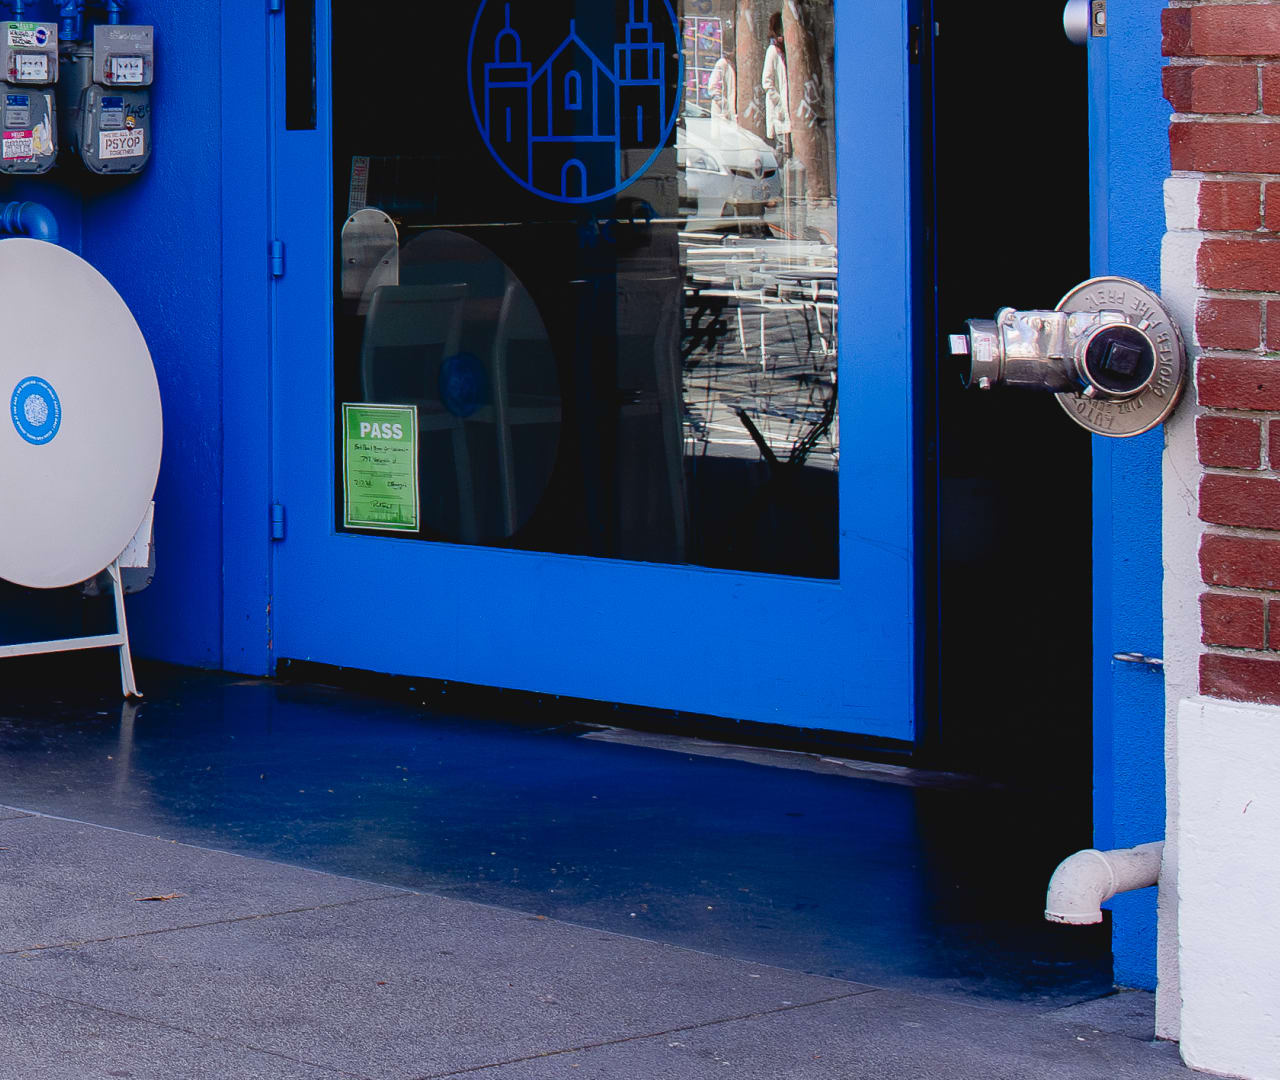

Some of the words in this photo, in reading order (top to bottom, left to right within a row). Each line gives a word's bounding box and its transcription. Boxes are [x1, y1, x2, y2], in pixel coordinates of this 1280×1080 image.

[105, 136, 140, 150] PSYOP
[1131, 296, 1162, 330] FIRE
[359, 422, 403, 439] PASS
